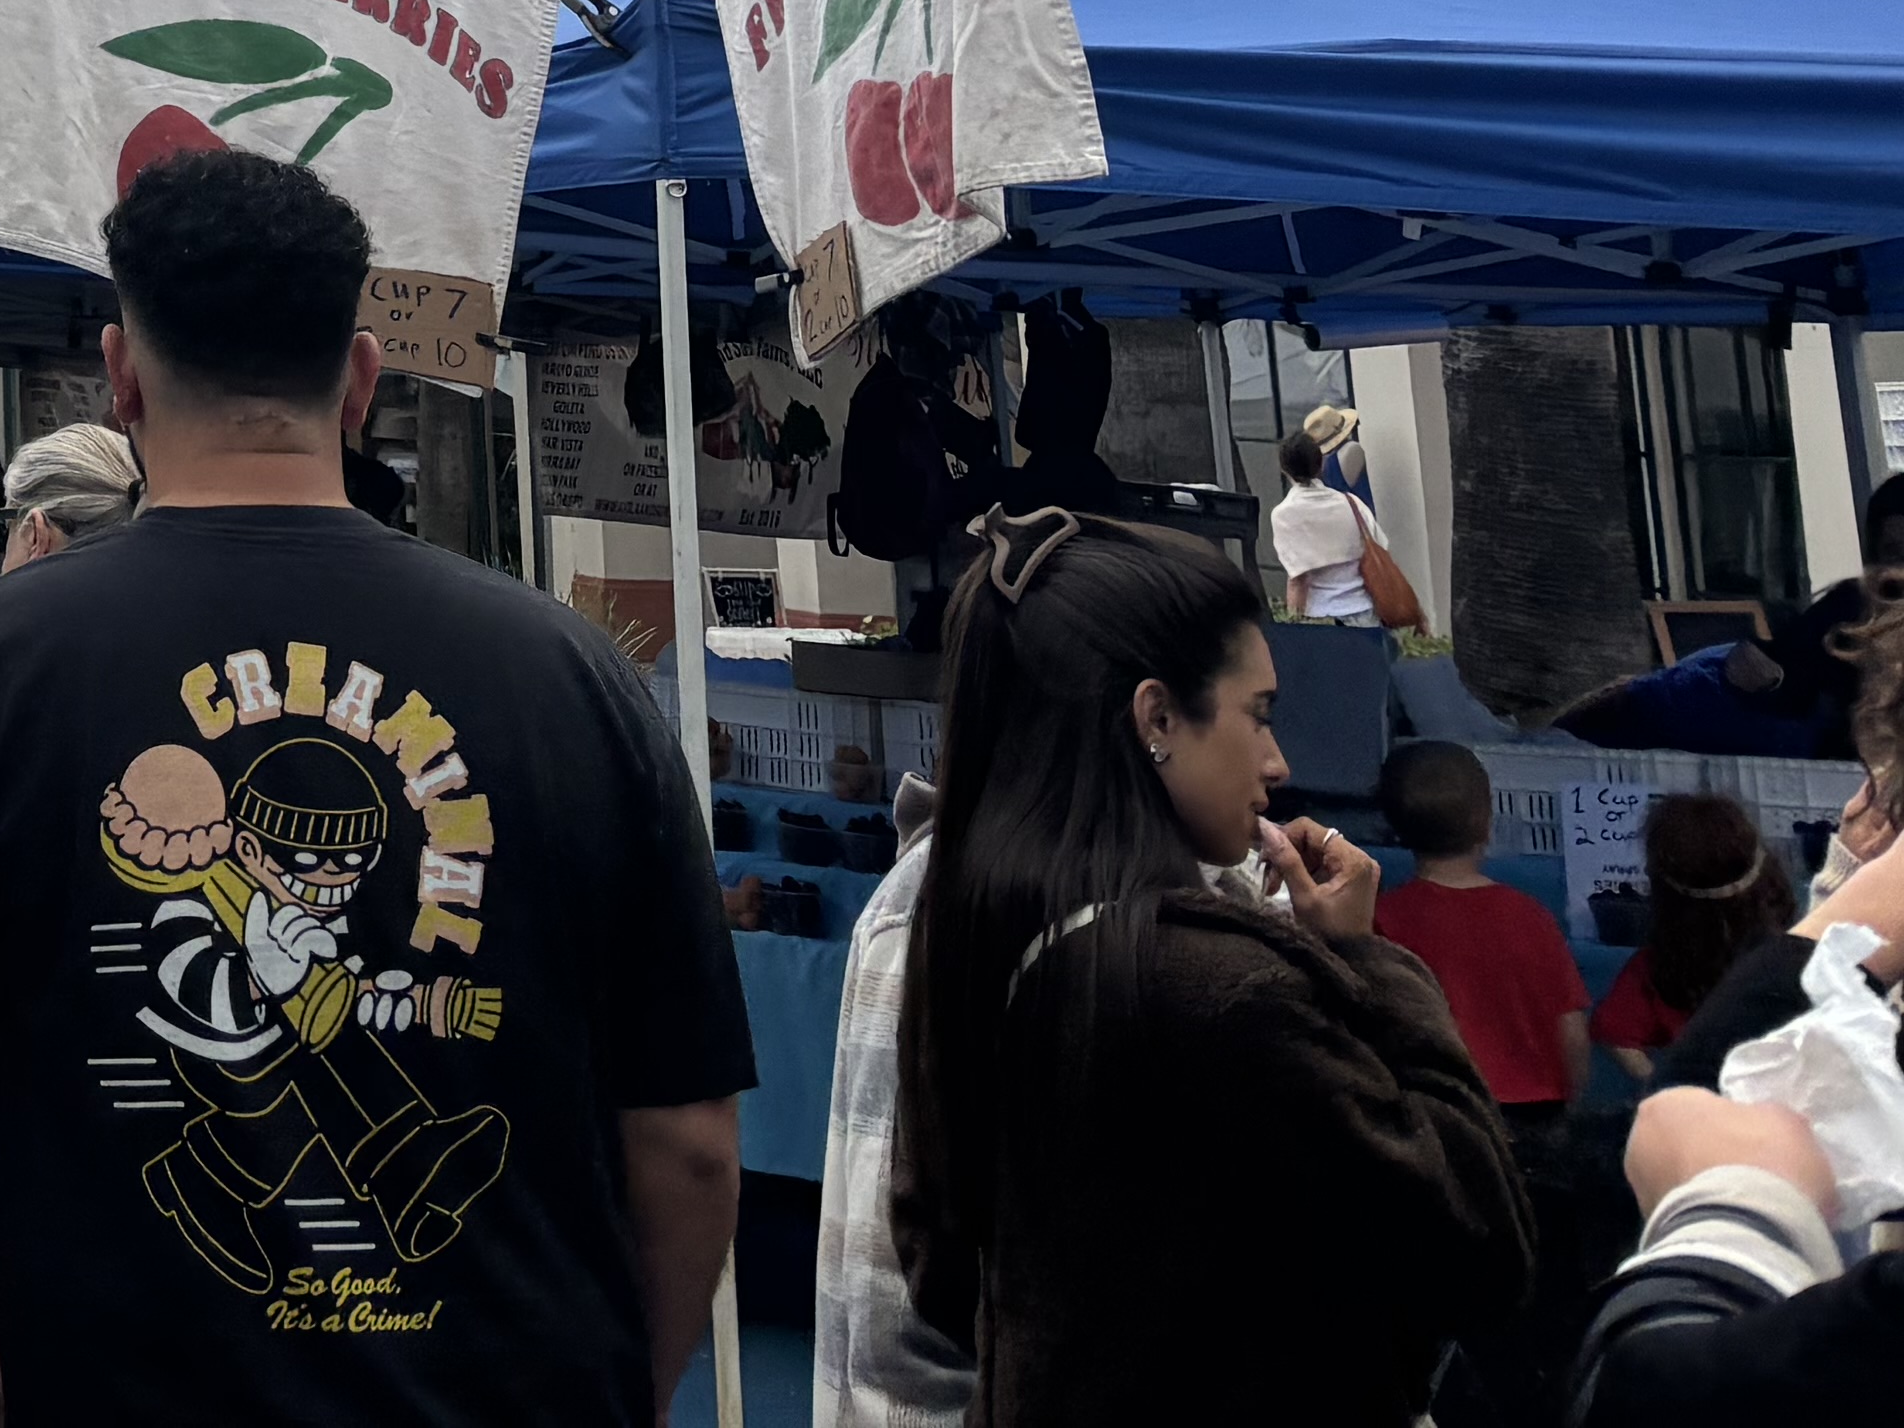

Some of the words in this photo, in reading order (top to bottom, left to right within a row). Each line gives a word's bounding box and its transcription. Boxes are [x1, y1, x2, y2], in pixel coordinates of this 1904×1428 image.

[445, 288, 468, 319] 7
[436, 337, 467, 368] 10
[1571, 786, 1585, 814] 1
[1574, 826, 1596, 845] 2
[283, 1266, 328, 1296] So
[330, 1266, 402, 1308] Good,
[267, 1300, 316, 1330] It's
[321, 1314, 344, 1332] a
[347, 1299, 443, 1333] Crime!
